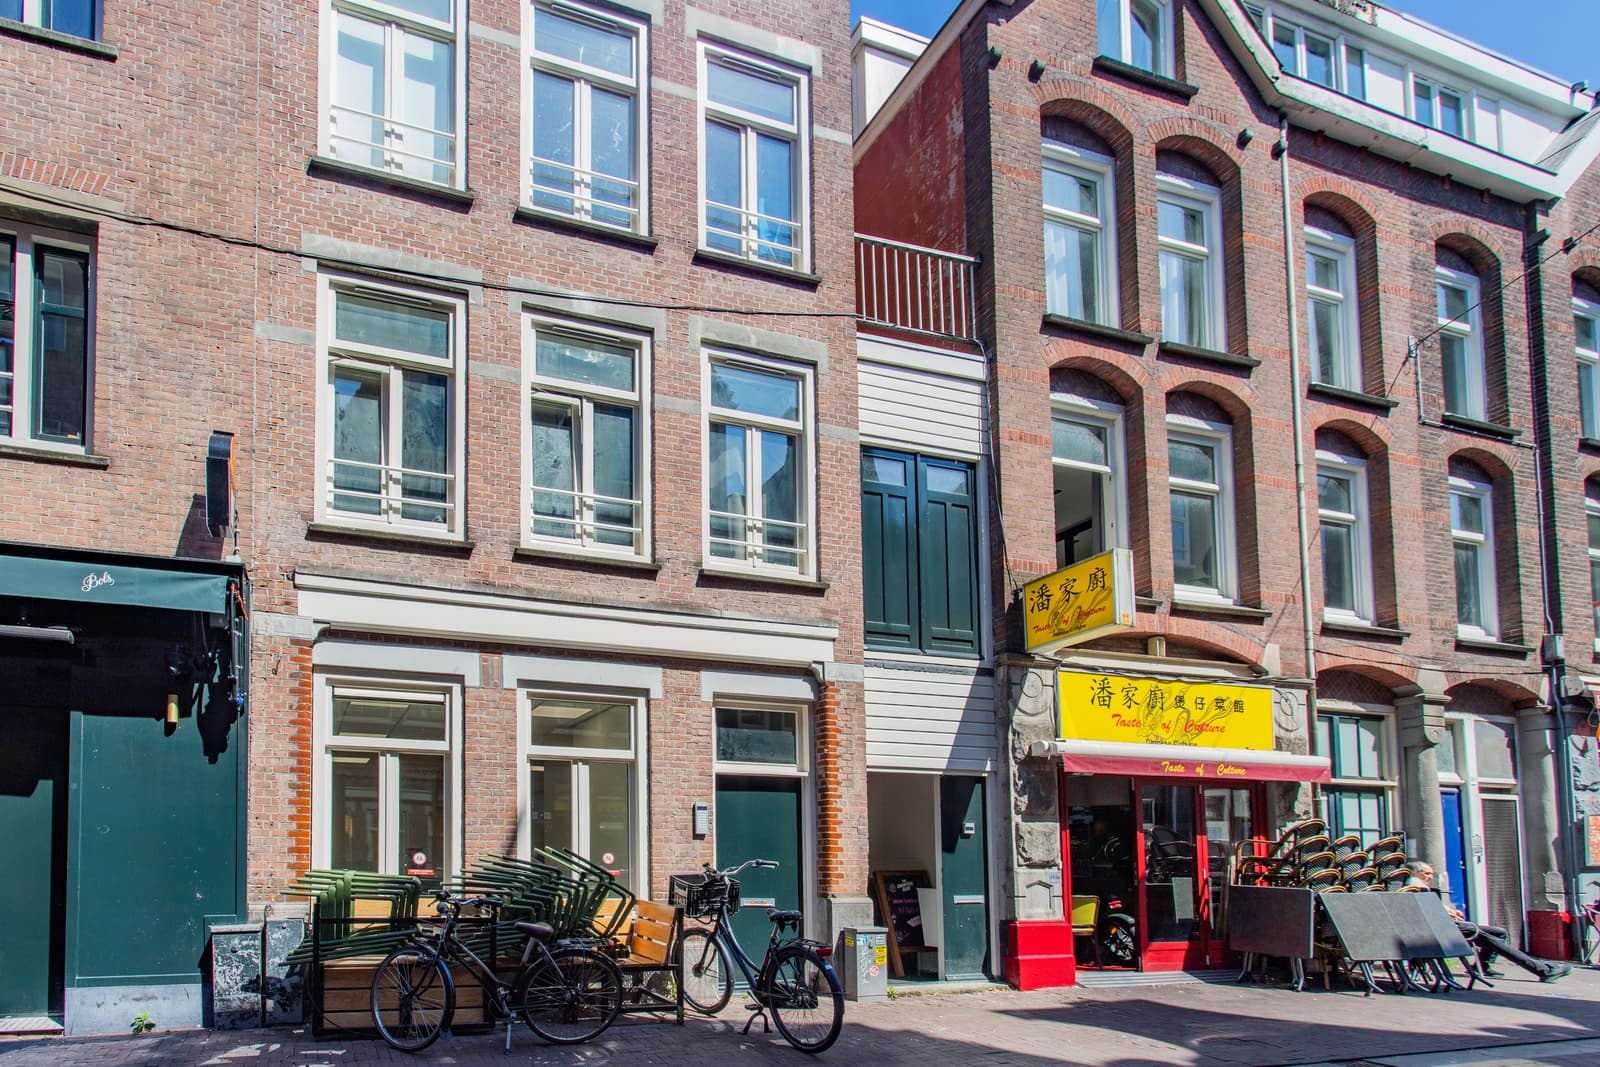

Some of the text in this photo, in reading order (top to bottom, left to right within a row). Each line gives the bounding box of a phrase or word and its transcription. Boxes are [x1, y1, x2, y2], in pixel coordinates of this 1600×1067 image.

[81, 571, 115, 592] Bols
[1030, 567, 1107, 613] 潘家廚
[1112, 713, 1226, 734] Taste of Culture
[1161, 760, 1247, 777] Taste of Culture
